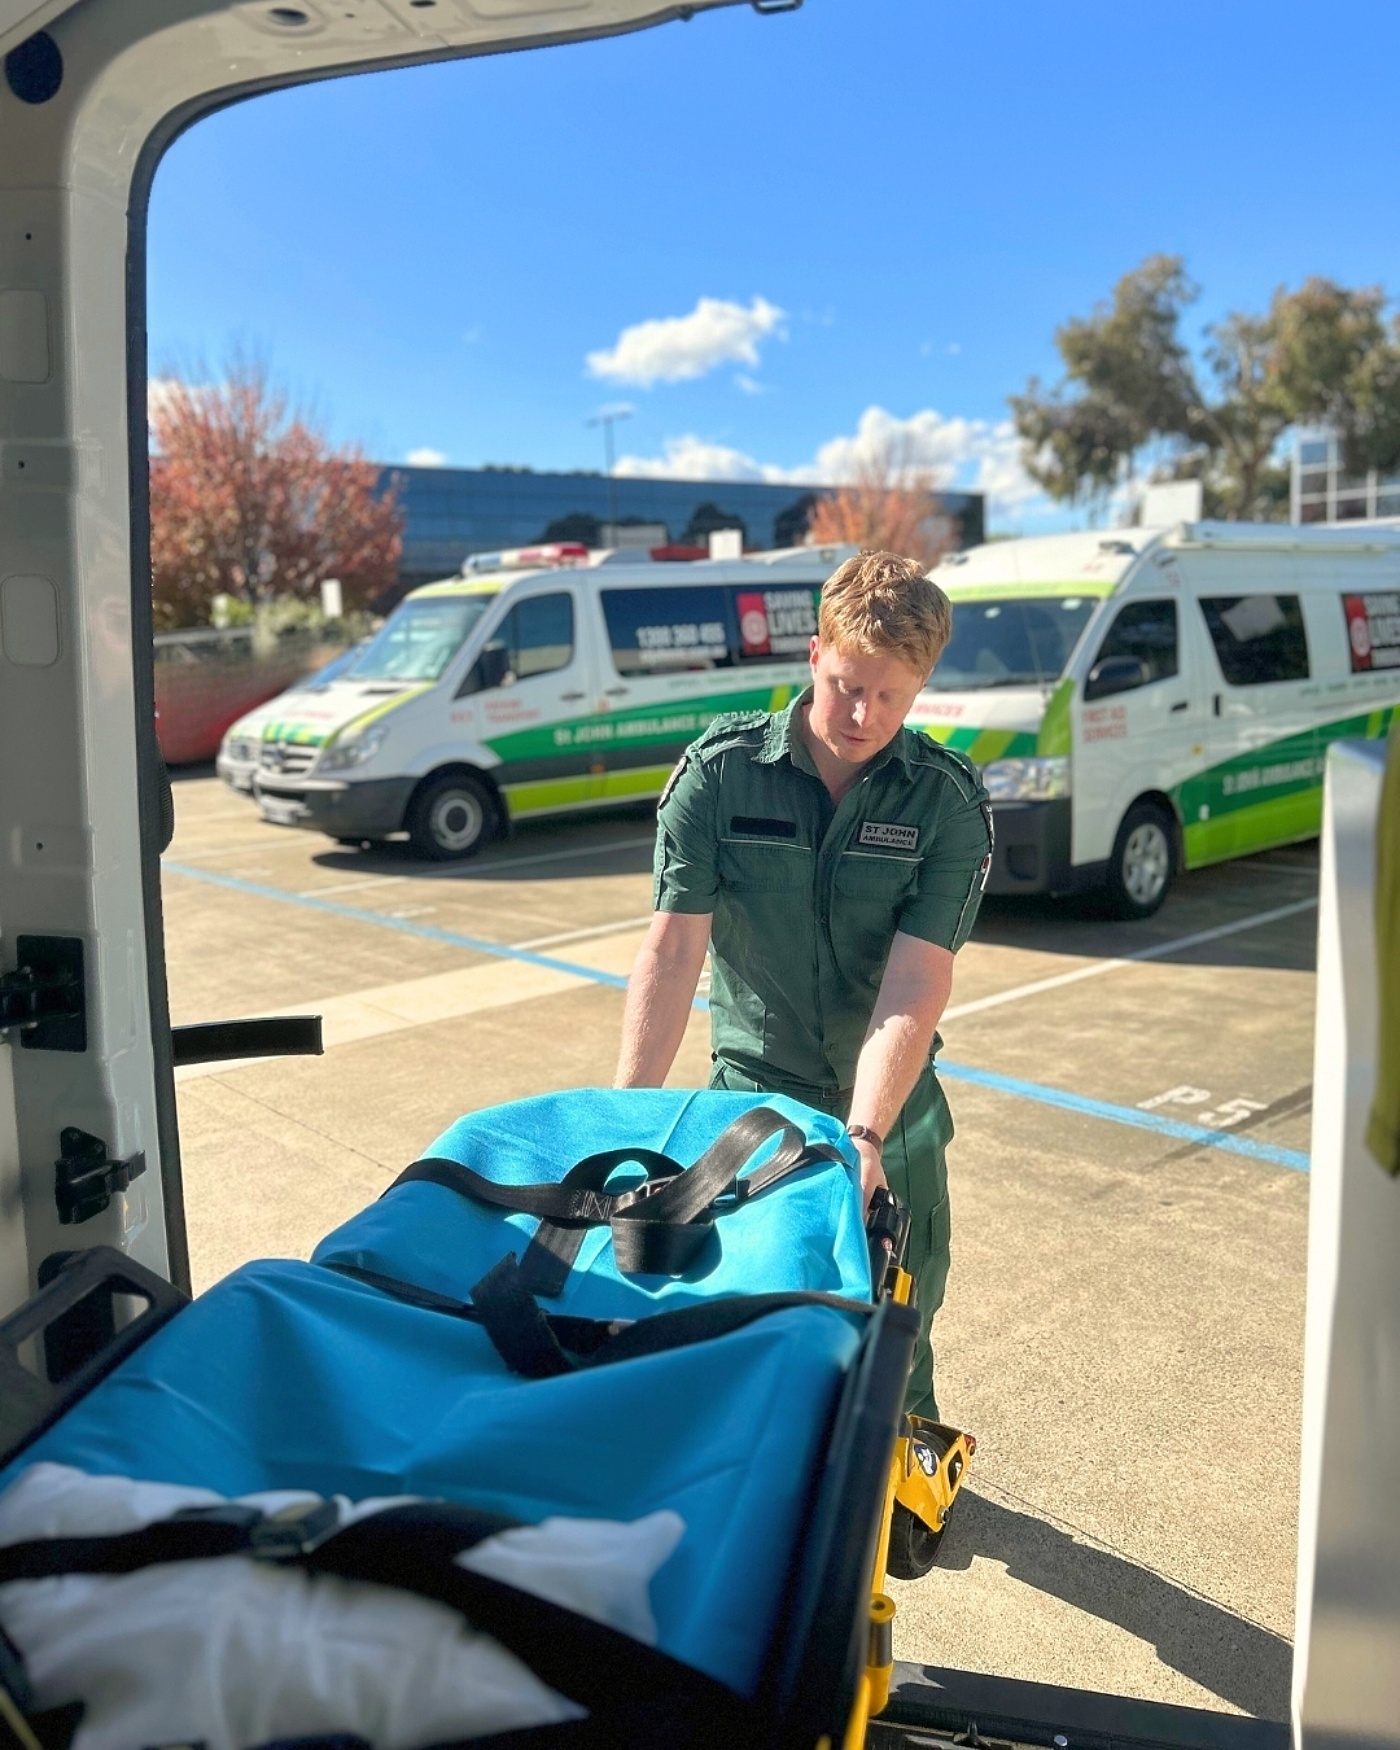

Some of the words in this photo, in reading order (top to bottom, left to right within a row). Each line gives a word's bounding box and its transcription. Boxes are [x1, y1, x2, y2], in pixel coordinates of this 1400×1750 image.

[767, 609, 817, 635] LIVES
[865, 825, 880, 834] ST
[882, 827, 916, 839] JOHN
